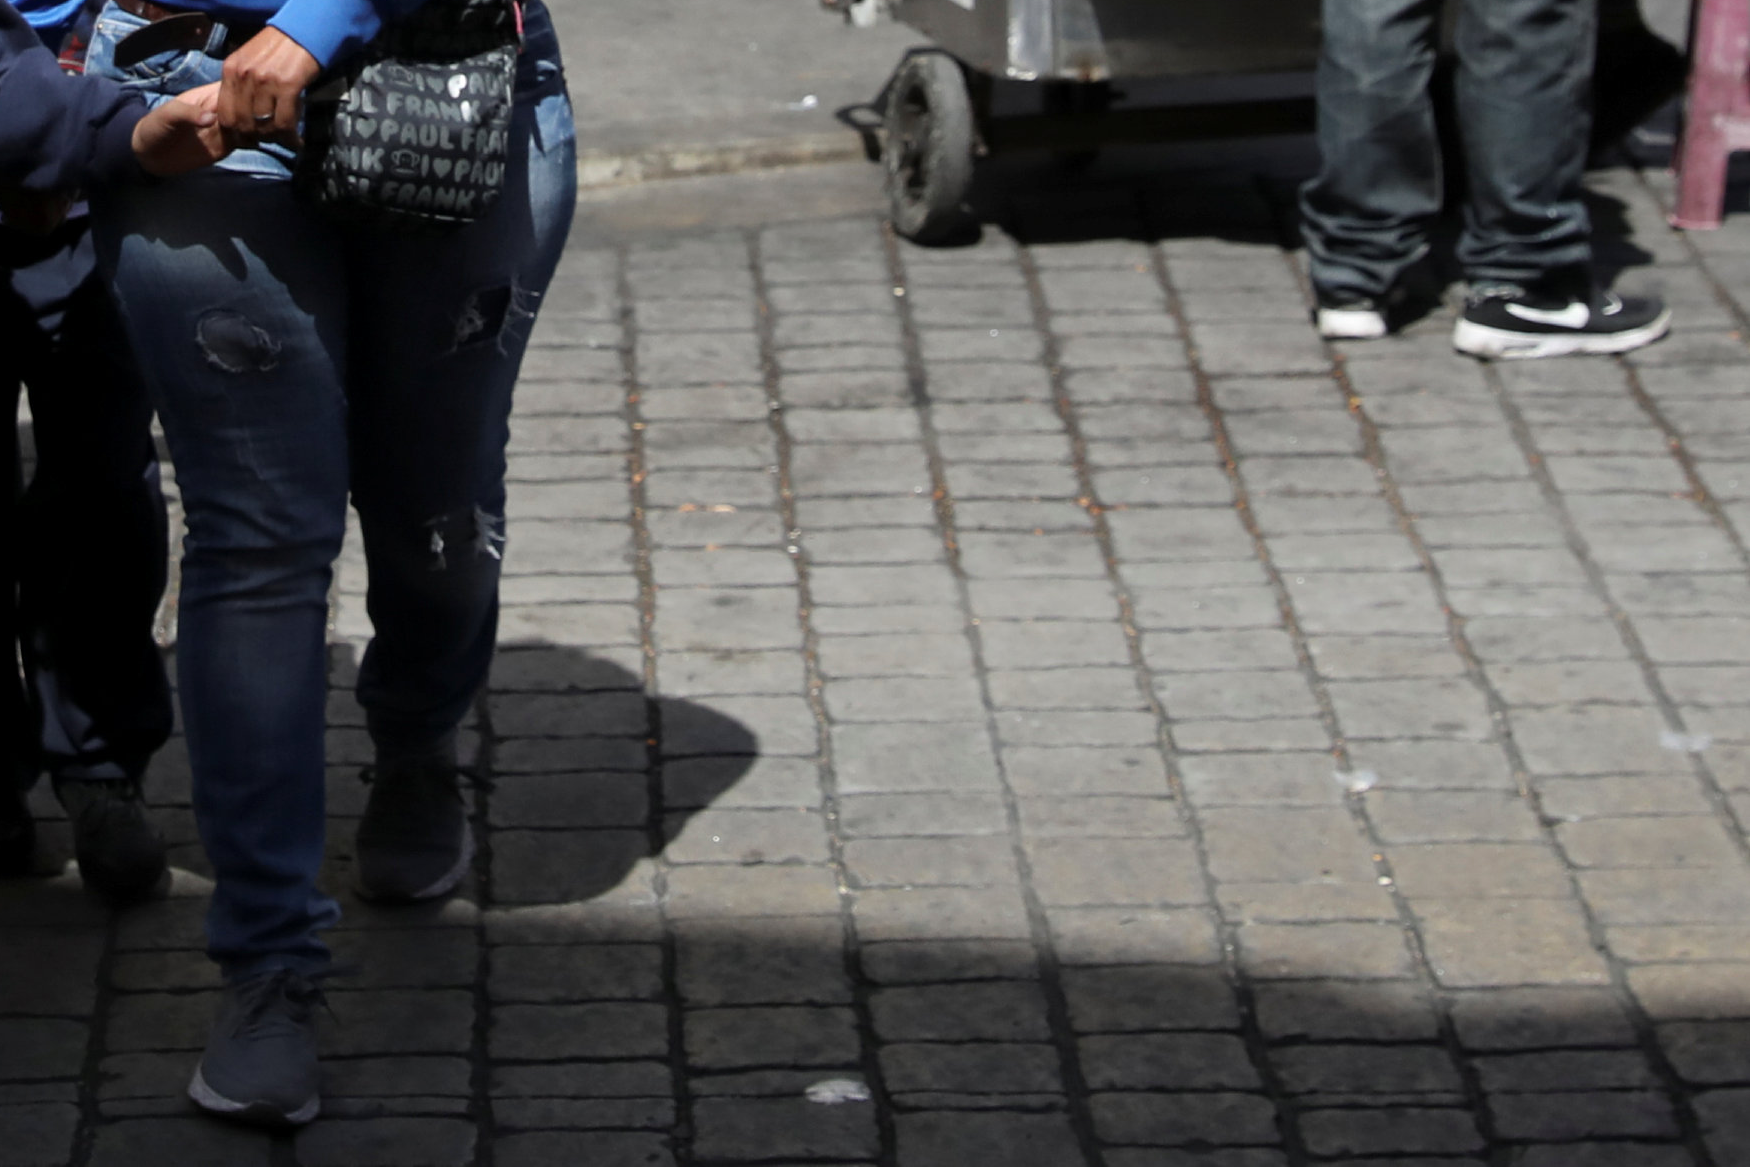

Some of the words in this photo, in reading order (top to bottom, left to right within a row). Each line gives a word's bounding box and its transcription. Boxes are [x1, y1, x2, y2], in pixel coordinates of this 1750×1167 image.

[386, 91, 481, 124] FRANK
[380, 117, 454, 150] PAUL
[381, 181, 475, 211] FRANK
